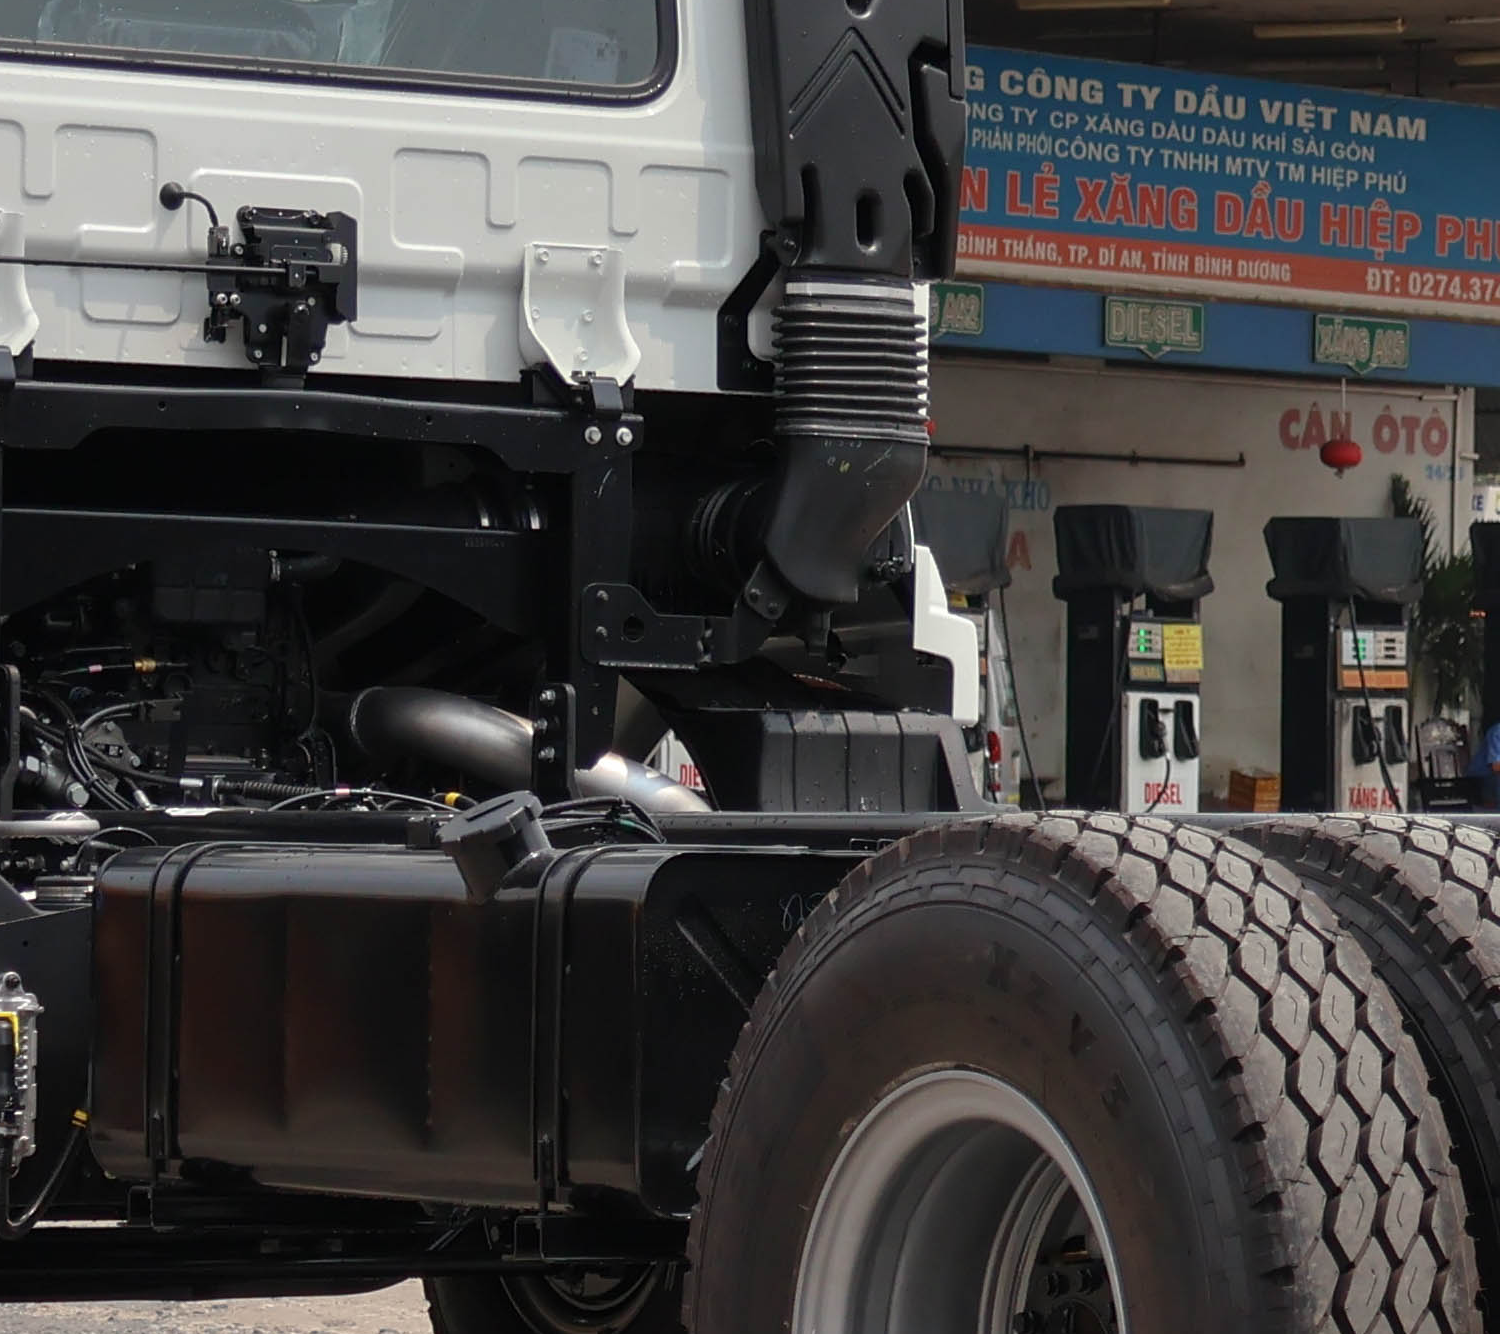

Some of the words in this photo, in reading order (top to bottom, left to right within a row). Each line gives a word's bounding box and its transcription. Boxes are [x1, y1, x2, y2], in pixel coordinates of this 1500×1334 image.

[1000, 67, 1104, 105] CÔNG
[1117, 83, 1162, 111] TY
[1174, 85, 1246, 120] DẦU
[1259, 99, 1338, 134] VIỆT
[1350, 110, 1427, 141] NAM
[1010, 106, 1038, 126] TY
[1049, 110, 1079, 129] CP
[1127, 145, 1154, 168] TY
[1160, 149, 1218, 174] TNHH
[1226, 155, 1270, 178] MTV
[1276, 162, 1306, 184] TM
[1006, 161, 1060, 218] LẺ
[1074, 172, 1199, 232] XĂNG
[1213, 180, 1304, 243] DẦU
[1319, 198, 1421, 261] HIỆP
[1068, 244, 1093, 265] TP.
[1108, 302, 1200, 344] DIESEL
[1372, 404, 1449, 458] ÔTÔ
[1143, 782, 1183, 806] DIESEL
